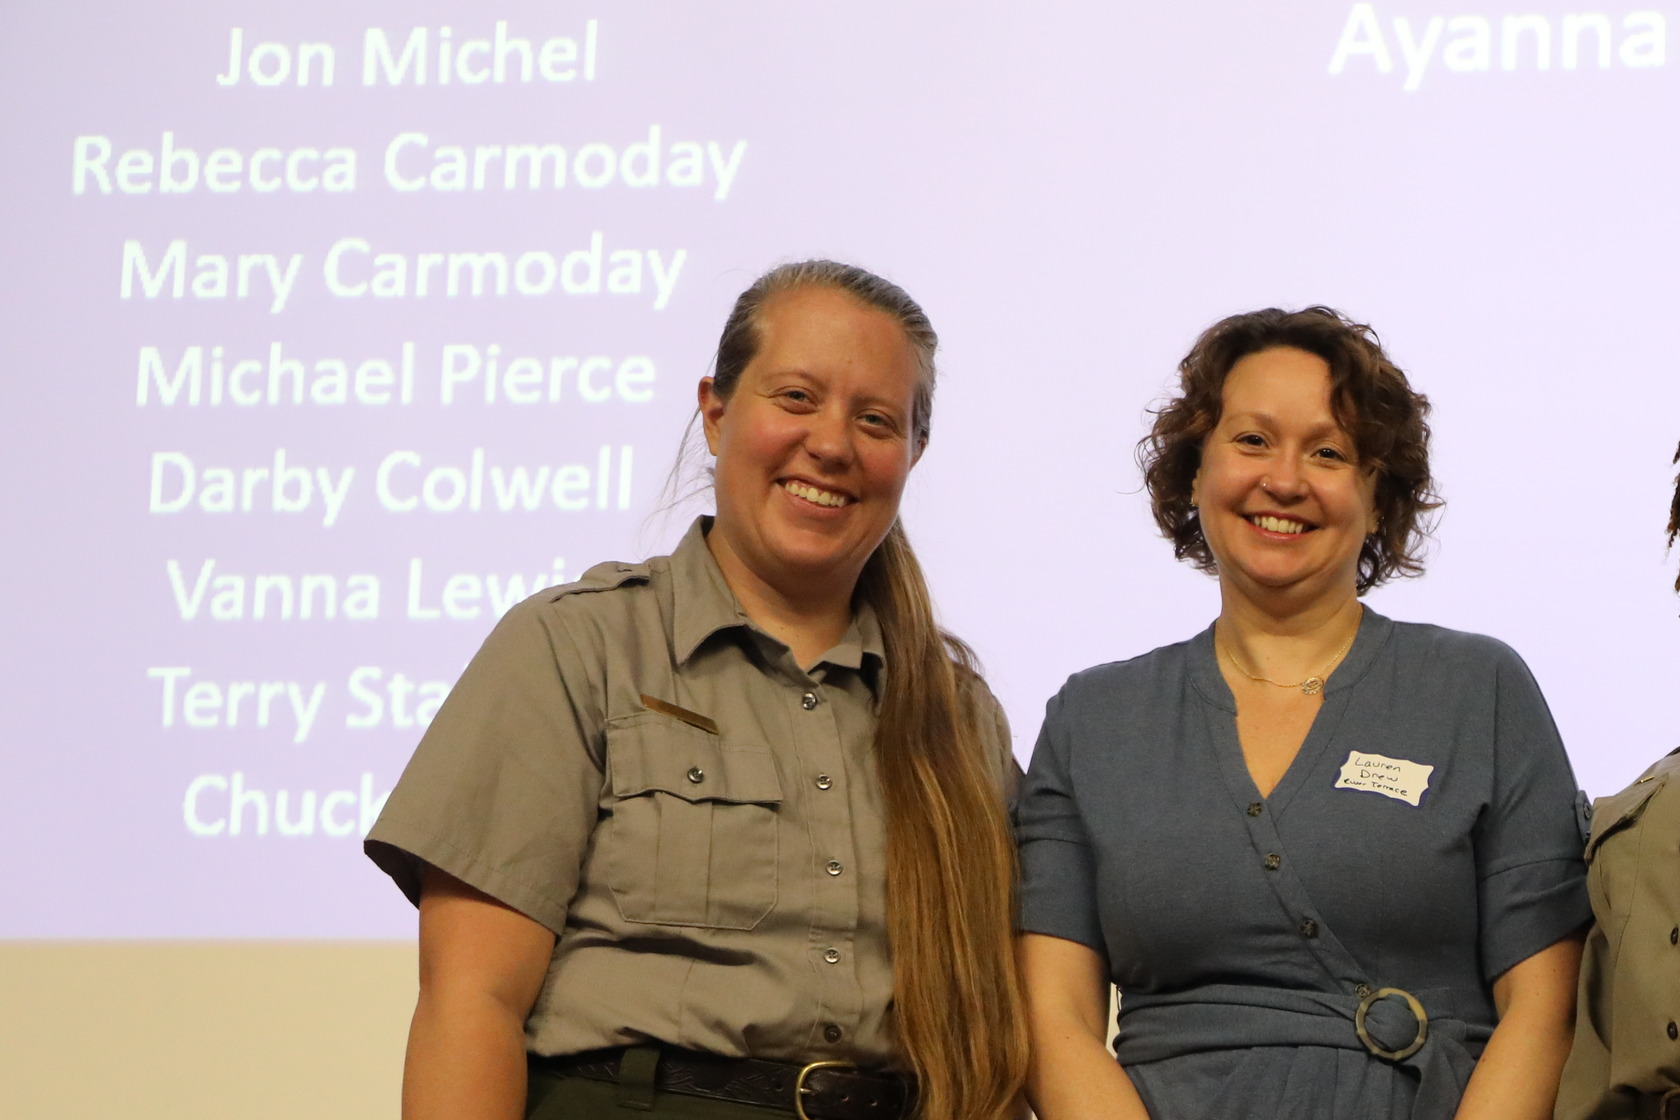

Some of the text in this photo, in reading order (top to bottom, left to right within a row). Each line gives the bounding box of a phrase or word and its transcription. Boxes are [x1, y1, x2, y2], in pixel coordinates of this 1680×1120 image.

[216, 19, 598, 87] Jon Michel
[1327, 2, 1667, 91] Ayanna
[71, 124, 748, 202] Rebecca Carmoday
[120, 231, 687, 313] Mary Carmoday
[135, 342, 656, 406] Michael Pierce
[148, 445, 634, 527] Darby Colwell
[167, 558, 381, 621] Vanna
[146, 662, 470, 743] Terry Sta
[1354, 757, 1401, 773] Lauren
[1360, 769, 1399, 783] Drew
[181, 772, 391, 837] Chuck
